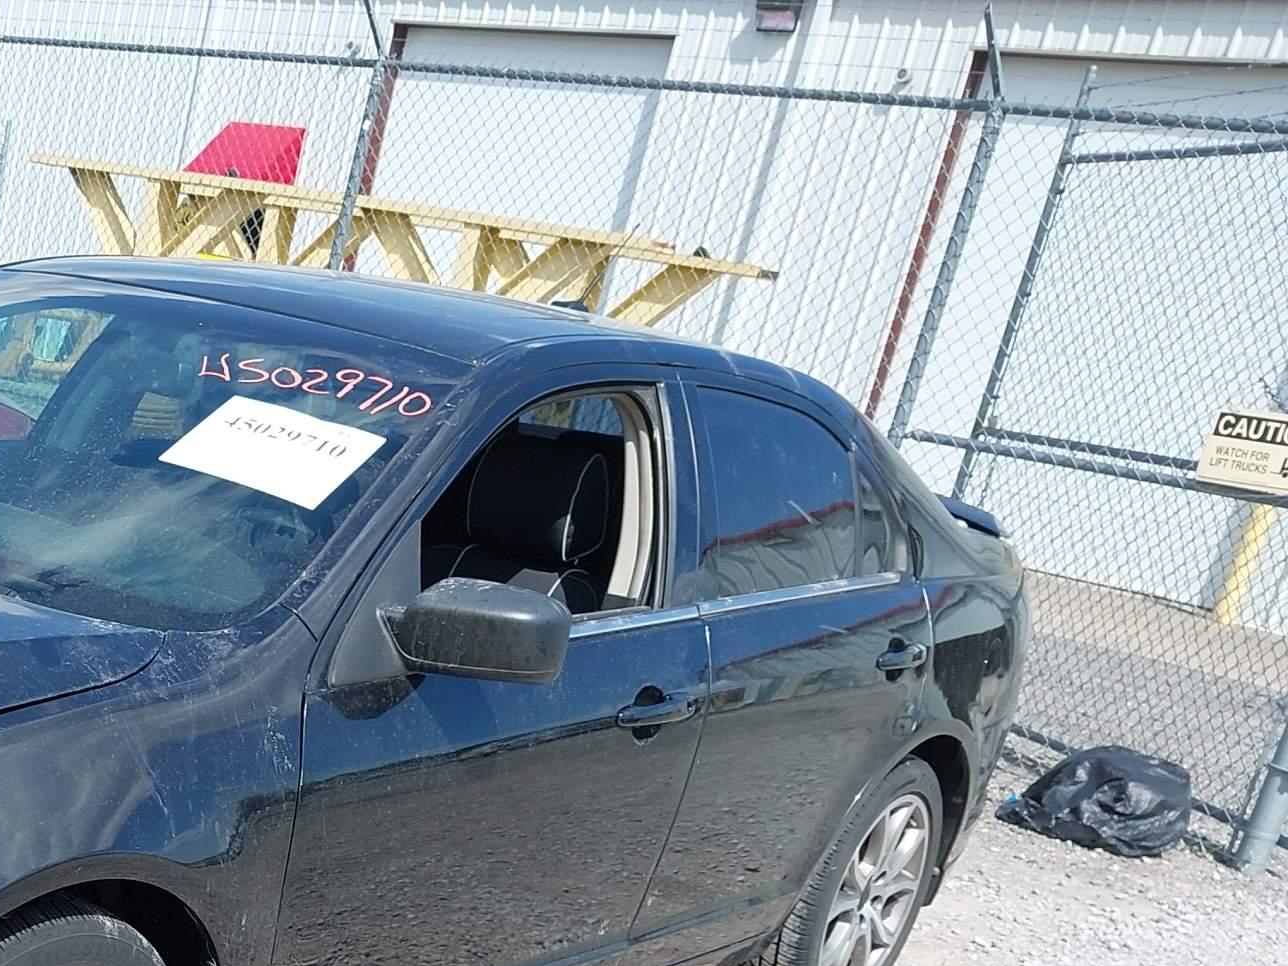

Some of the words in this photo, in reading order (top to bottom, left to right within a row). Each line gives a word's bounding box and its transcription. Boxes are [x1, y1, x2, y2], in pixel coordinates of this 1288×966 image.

[224, 416, 348, 458] 45029710
[1216, 445, 1249, 459] WATCH
[1250, 450, 1270, 462] FOR
[1209, 457, 1230, 469] LIFT
[1230, 460, 1268, 475] TRUCKS
